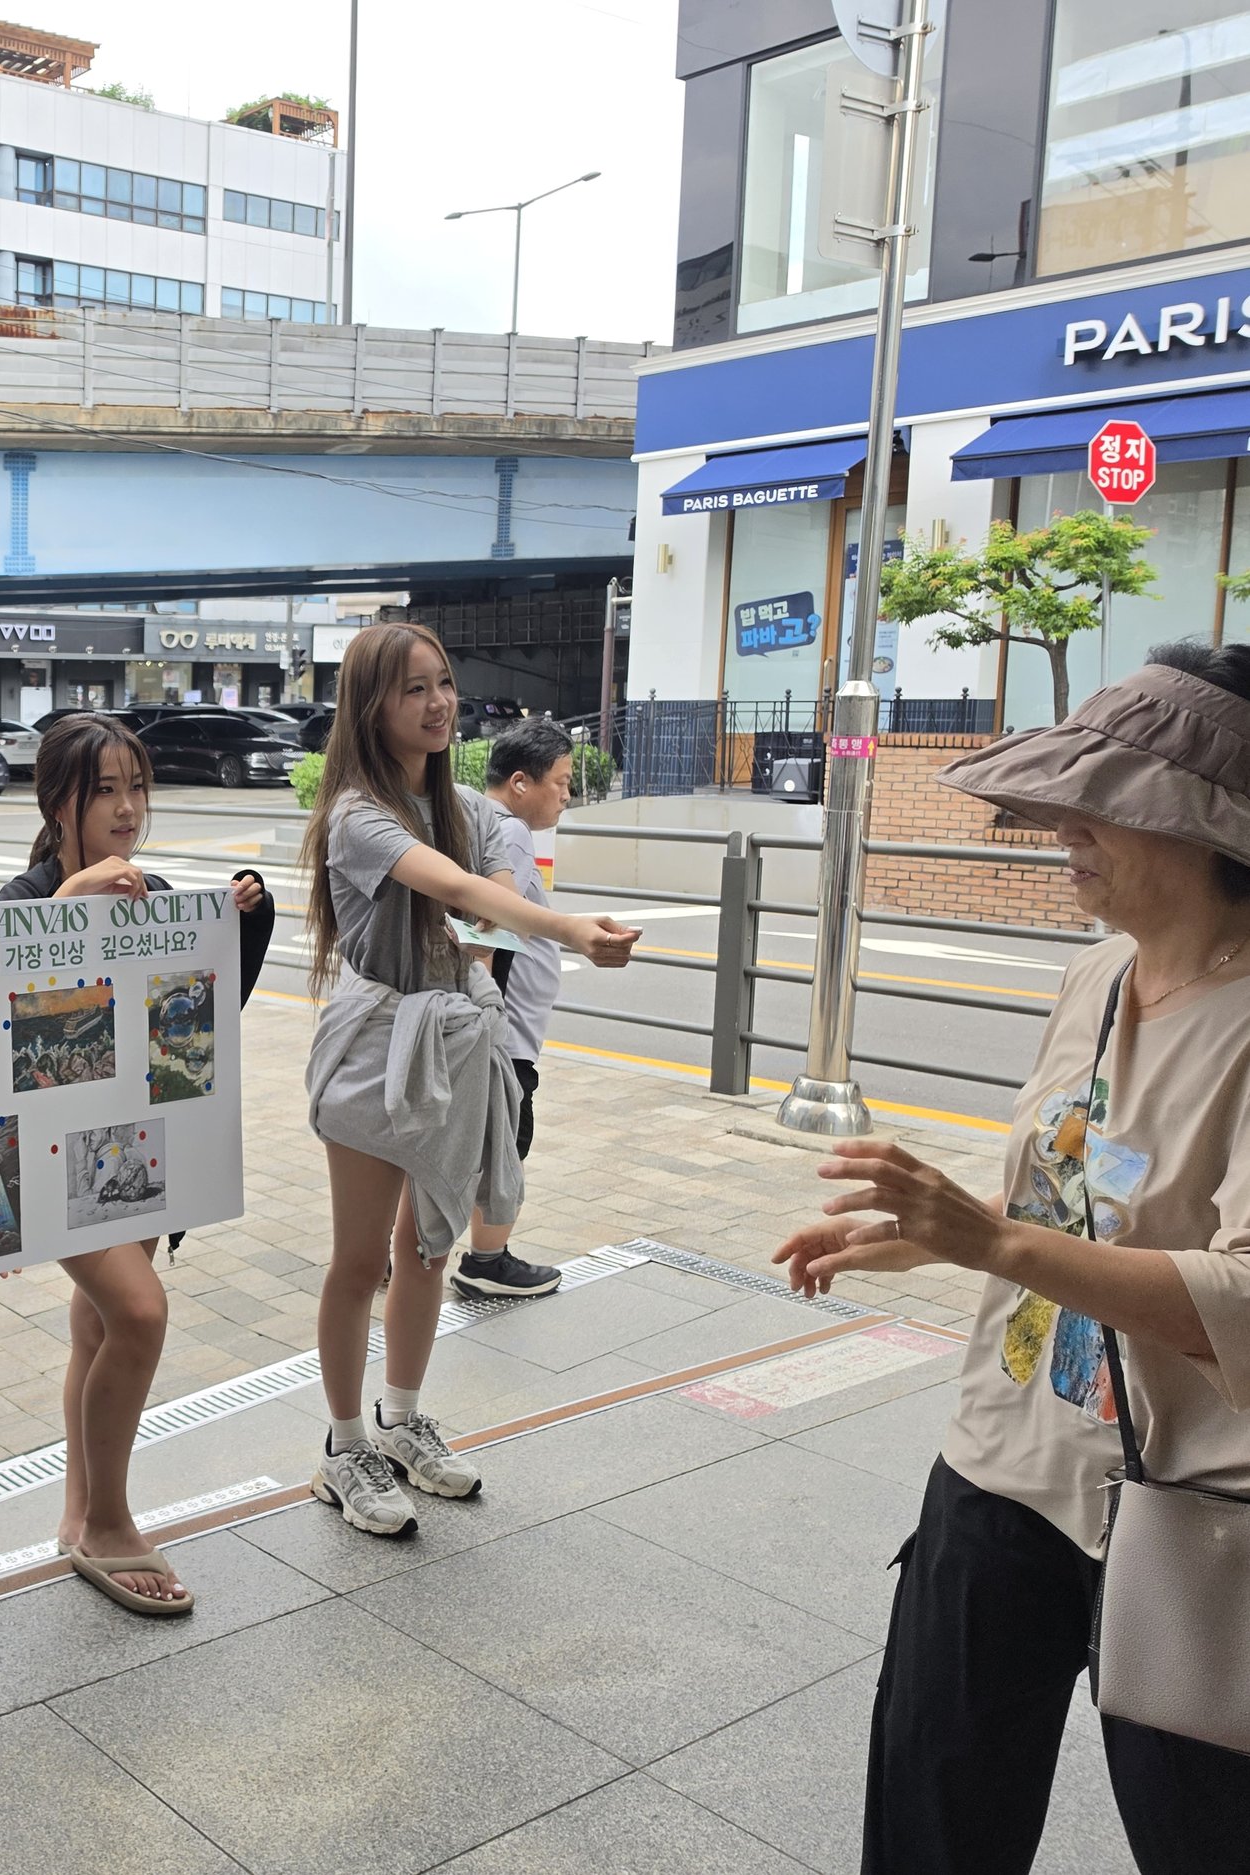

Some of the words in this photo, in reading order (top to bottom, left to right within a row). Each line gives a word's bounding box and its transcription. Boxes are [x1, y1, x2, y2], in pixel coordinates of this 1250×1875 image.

[1099, 434, 1146, 466] 정지
[1097, 466, 1145, 490] STOP
[683, 494, 729, 512] PARIS
[733, 484, 818, 507] BAGUETTE
[740, 607, 756, 627] 밥
[758, 600, 790, 622] 먹고
[109, 891, 228, 928] SOCIETY
[5, 942, 43, 971] 가장
[48, 939, 86, 968] 인상
[100, 930, 197, 961] 깊으셨나요?
